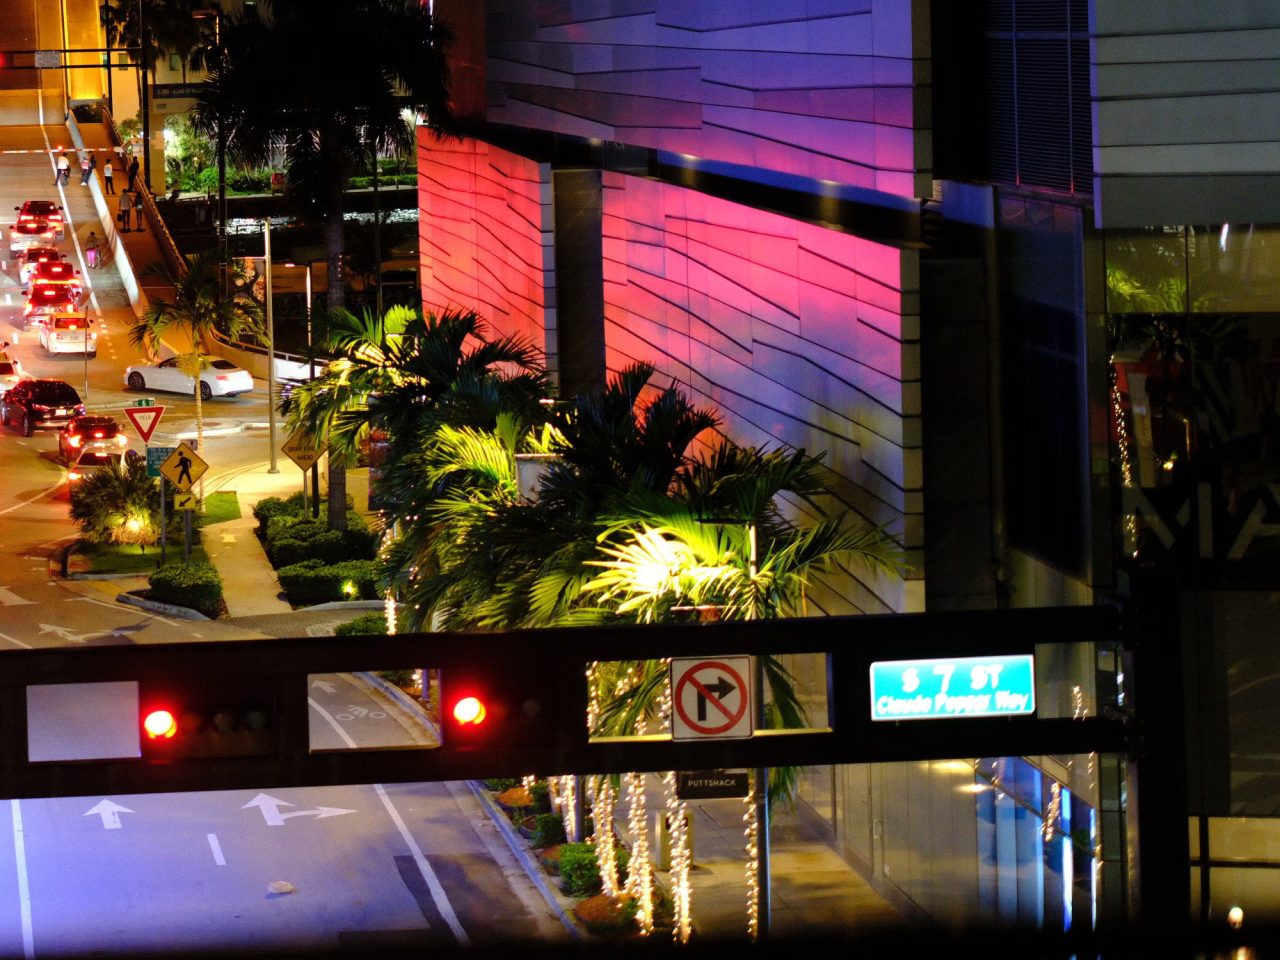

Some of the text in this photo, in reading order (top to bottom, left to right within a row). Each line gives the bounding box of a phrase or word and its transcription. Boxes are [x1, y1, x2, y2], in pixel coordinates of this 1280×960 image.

[901, 664, 1002, 694] S 7 ST
[687, 778, 736, 787] PUTTSHACK
